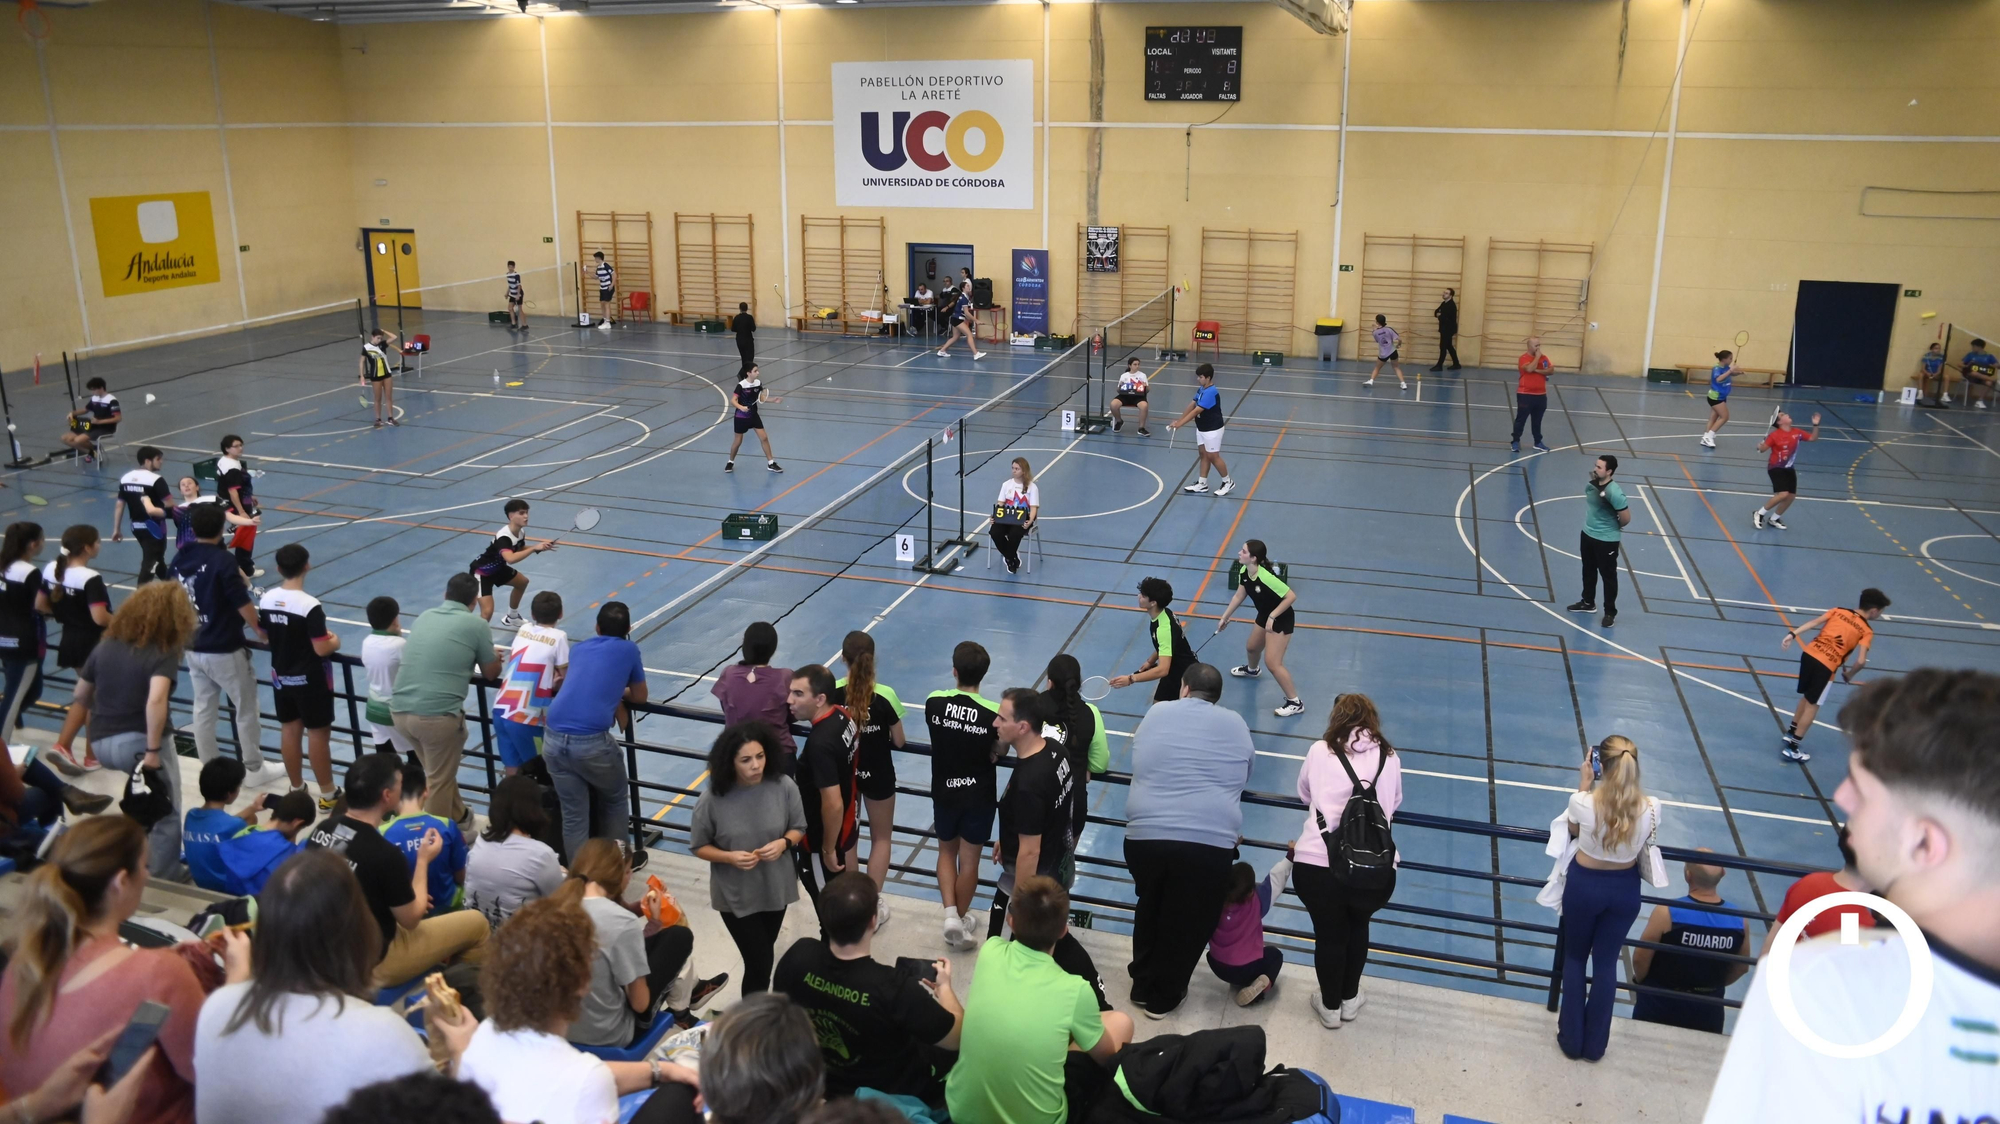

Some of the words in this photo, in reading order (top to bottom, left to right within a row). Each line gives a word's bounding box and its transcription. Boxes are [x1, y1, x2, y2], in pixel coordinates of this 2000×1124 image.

[1147, 48, 1172, 56] LOCAL
[860, 75, 924, 87] PABELLÓN
[929, 75, 1004, 87] DEPORTIVO
[901, 90, 917, 100] LA
[922, 88, 961, 100] ARETÉ
[861, 109, 1004, 172] UCO
[862, 178, 933, 187] UNIVERSIDAD
[935, 178, 950, 187] DE
[952, 177, 1005, 188] CÓRDOBA
[143, 274, 169, 284] Deporte
[171, 270, 197, 280] Andaluz
[1066, 413, 1071, 423] 5
[996, 508, 1005, 518] 5
[1016, 510, 1024, 520] 7
[901, 538, 909, 551] 6
[945, 702, 978, 723] PRIETO
[963, 723, 988, 735] MORENA
[311, 828, 338, 849] LOST
[1681, 931, 1734, 949] EDUARDO
[803, 971, 860, 1003] ALEJANDRO
[860, 992, 871, 1006] E.
